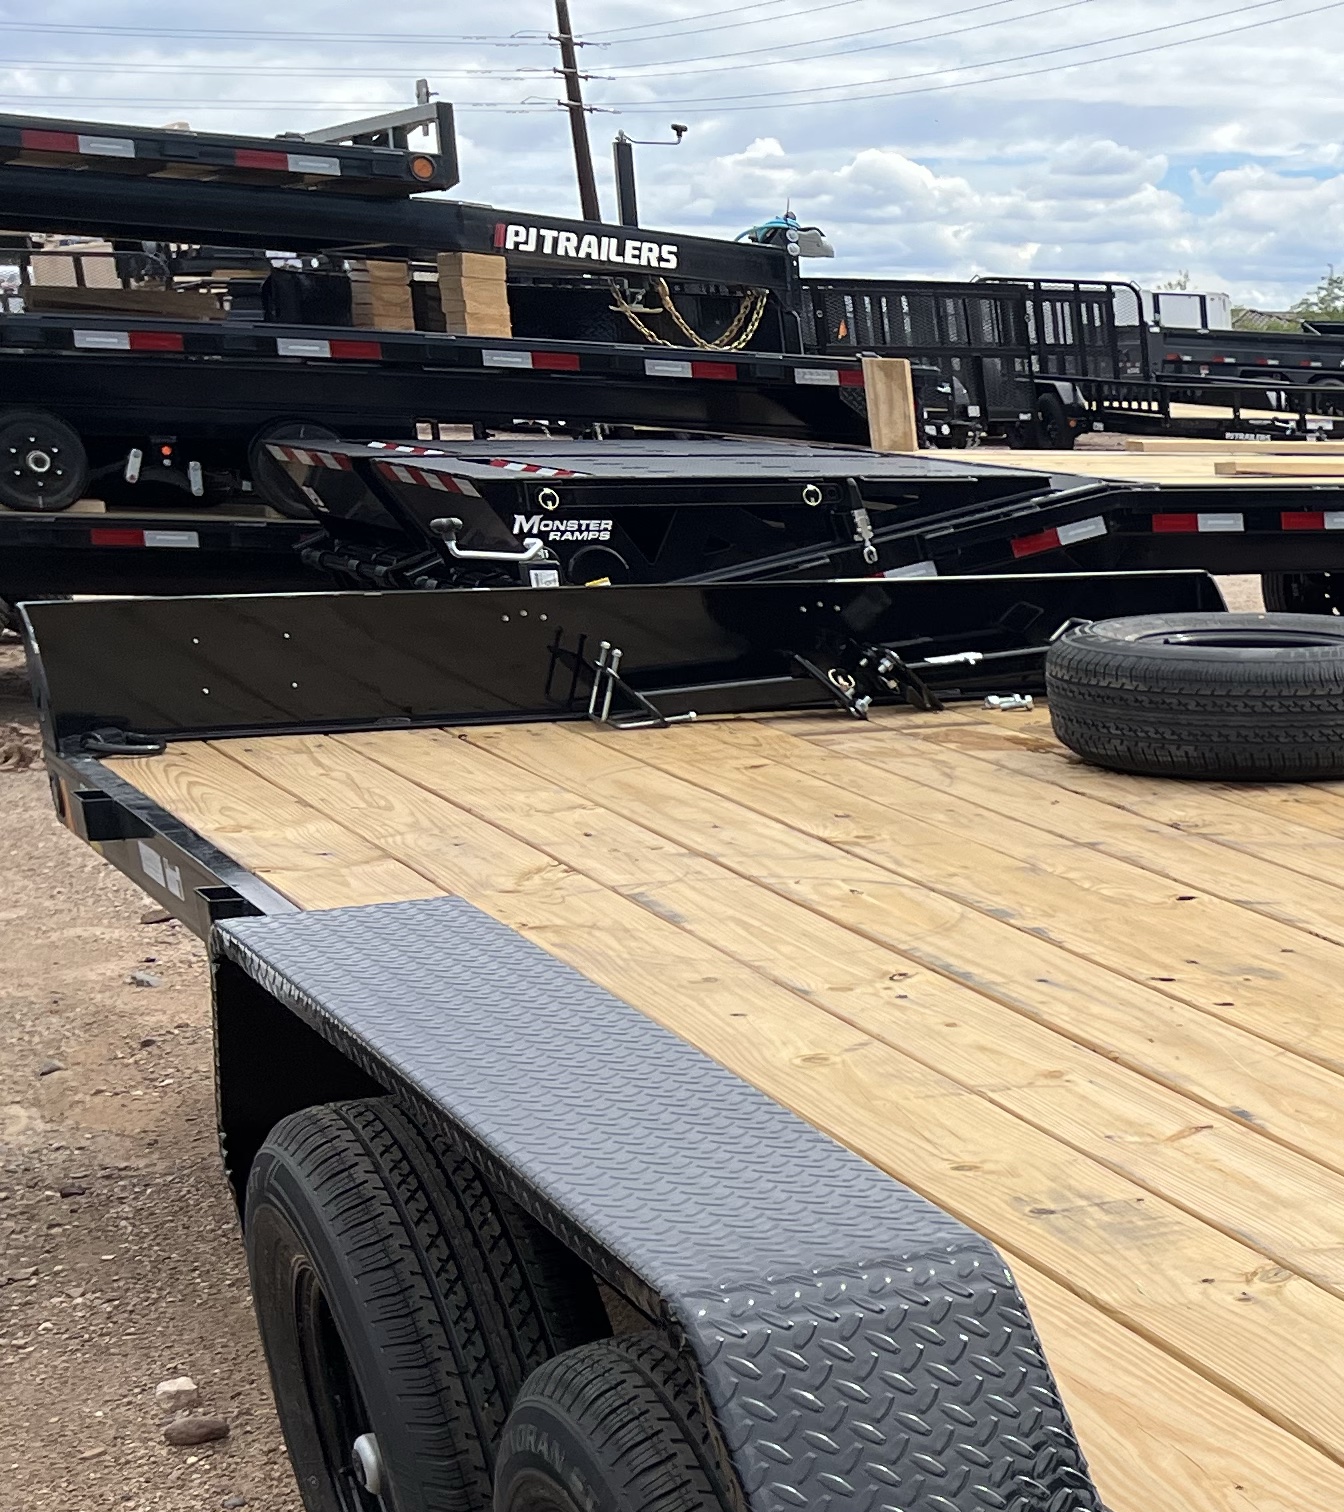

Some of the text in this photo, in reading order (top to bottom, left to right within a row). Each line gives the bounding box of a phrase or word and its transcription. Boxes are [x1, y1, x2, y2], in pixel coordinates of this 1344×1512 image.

[505, 224, 678, 269] PJ TRAILERS
[548, 531, 611, 541] RAMPS
